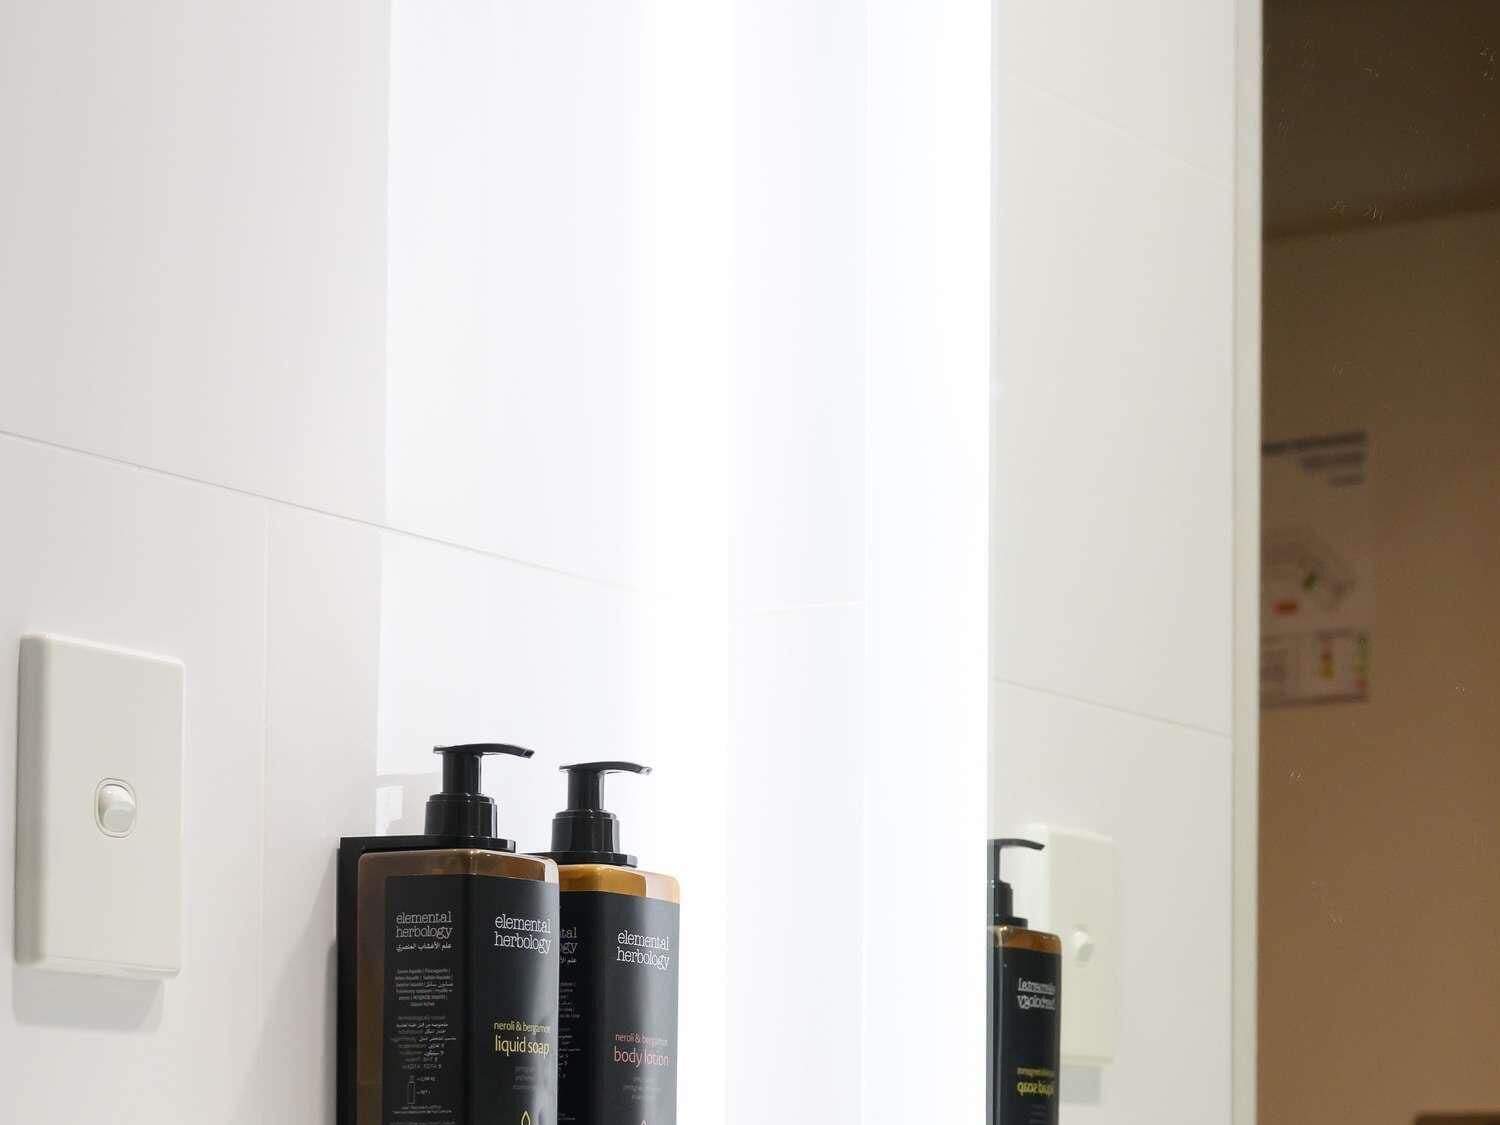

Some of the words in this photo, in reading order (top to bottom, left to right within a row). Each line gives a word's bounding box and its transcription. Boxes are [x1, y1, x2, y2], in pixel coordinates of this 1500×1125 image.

[396, 911, 452, 924] elemental
[494, 914, 552, 934] elemental
[395, 925, 453, 940] herbology
[494, 931, 552, 954] herbology
[617, 930, 670, 951] elemental
[616, 946, 670, 971] herbology
[494, 1020, 515, 1031] neroli
[515, 1021, 522, 1032] &
[495, 1034, 526, 1057] liquid
[527, 1040, 550, 1060] soap
[615, 1033, 634, 1043] neroli
[614, 1045, 643, 1068] body
[644, 1047, 669, 1066] lotion
